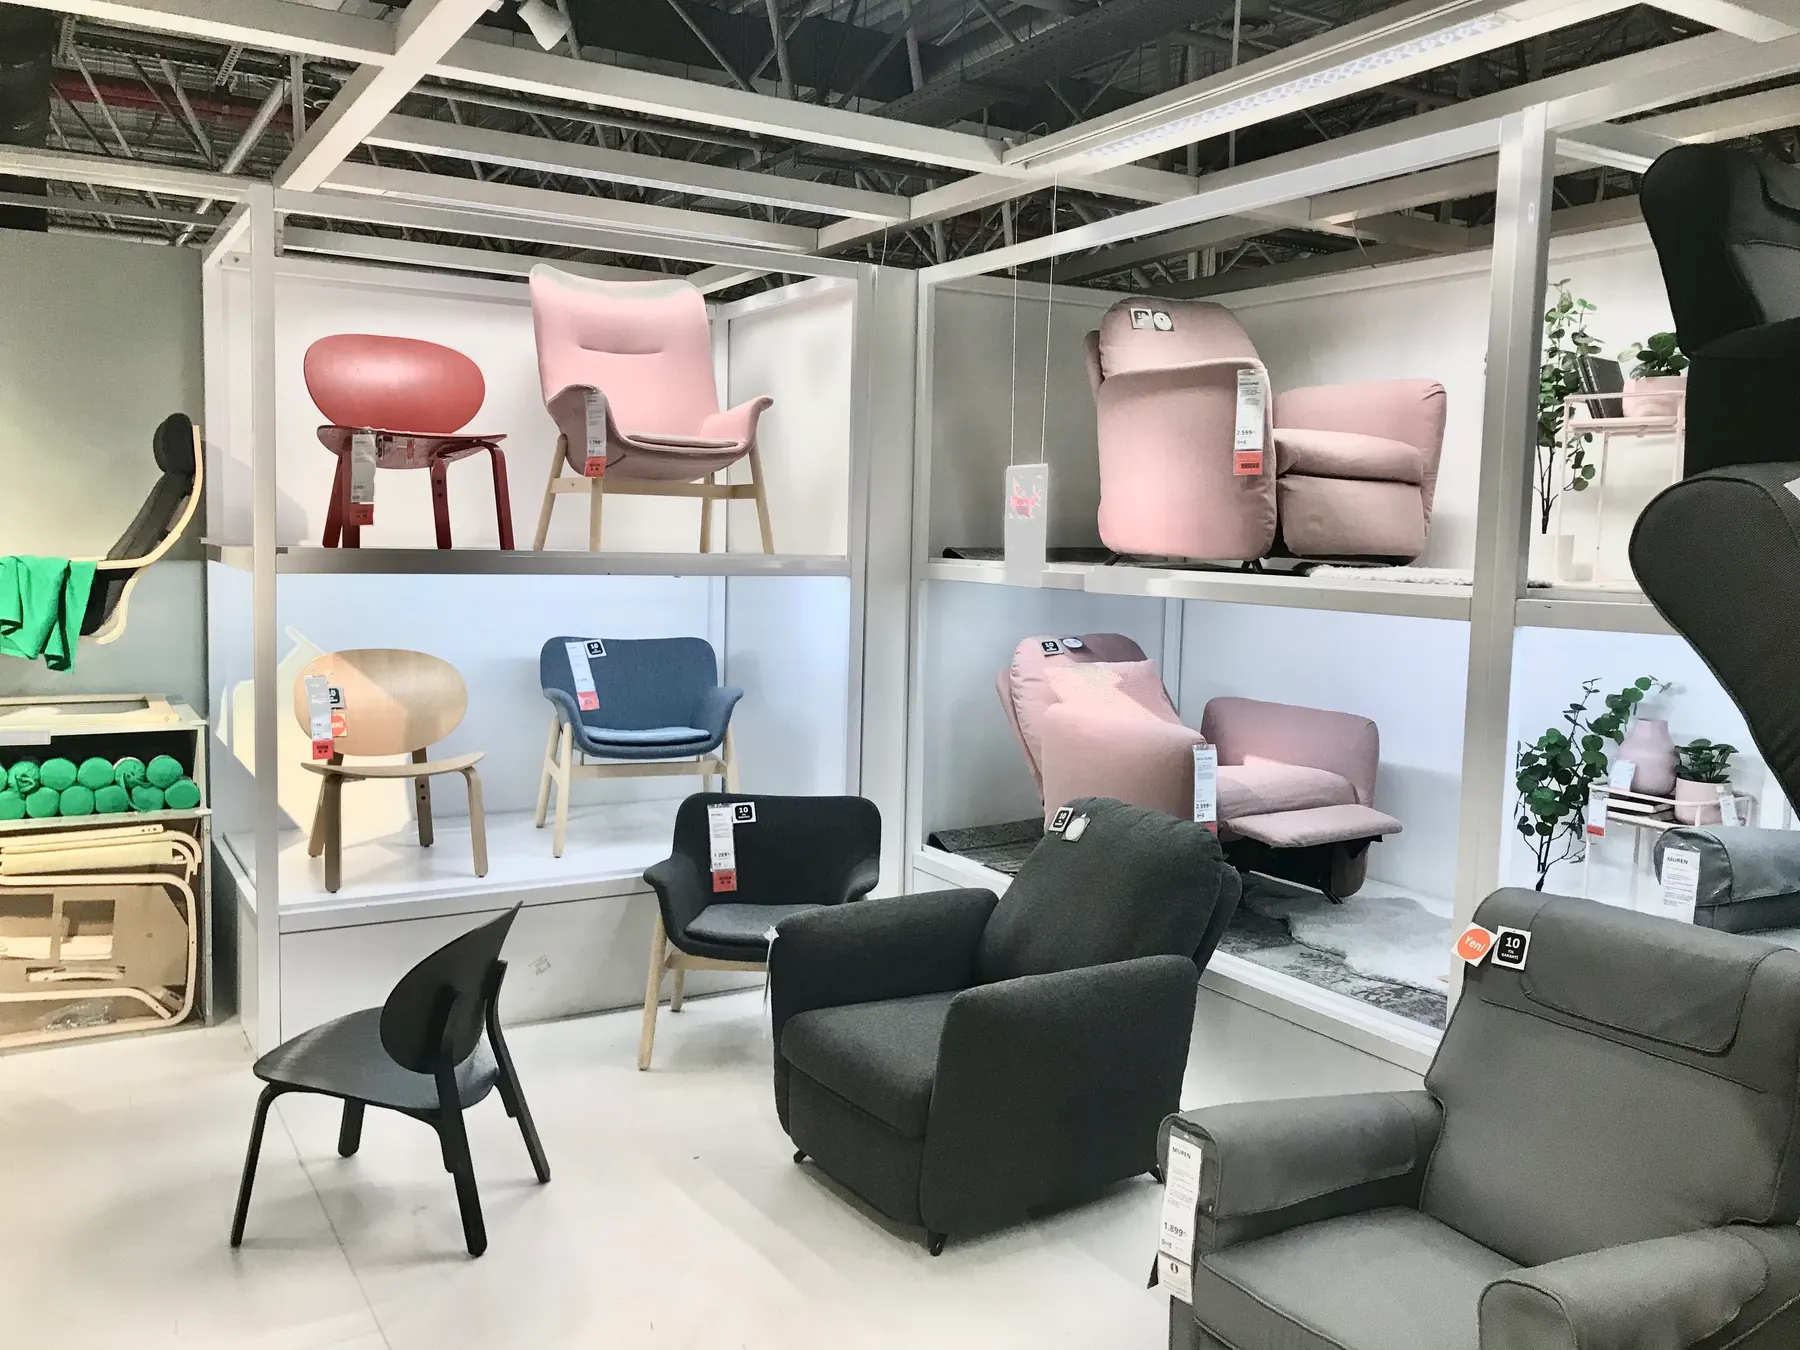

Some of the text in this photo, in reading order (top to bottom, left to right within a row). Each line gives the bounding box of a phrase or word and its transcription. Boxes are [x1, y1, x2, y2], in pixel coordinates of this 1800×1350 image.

[1667, 856, 1689, 865] MUREN
[1464, 935, 1487, 952] Yeni
[1505, 936, 1521, 949] 10
[1172, 1146, 1192, 1159] MUREN
[1164, 1221, 1184, 1237] 1.899
